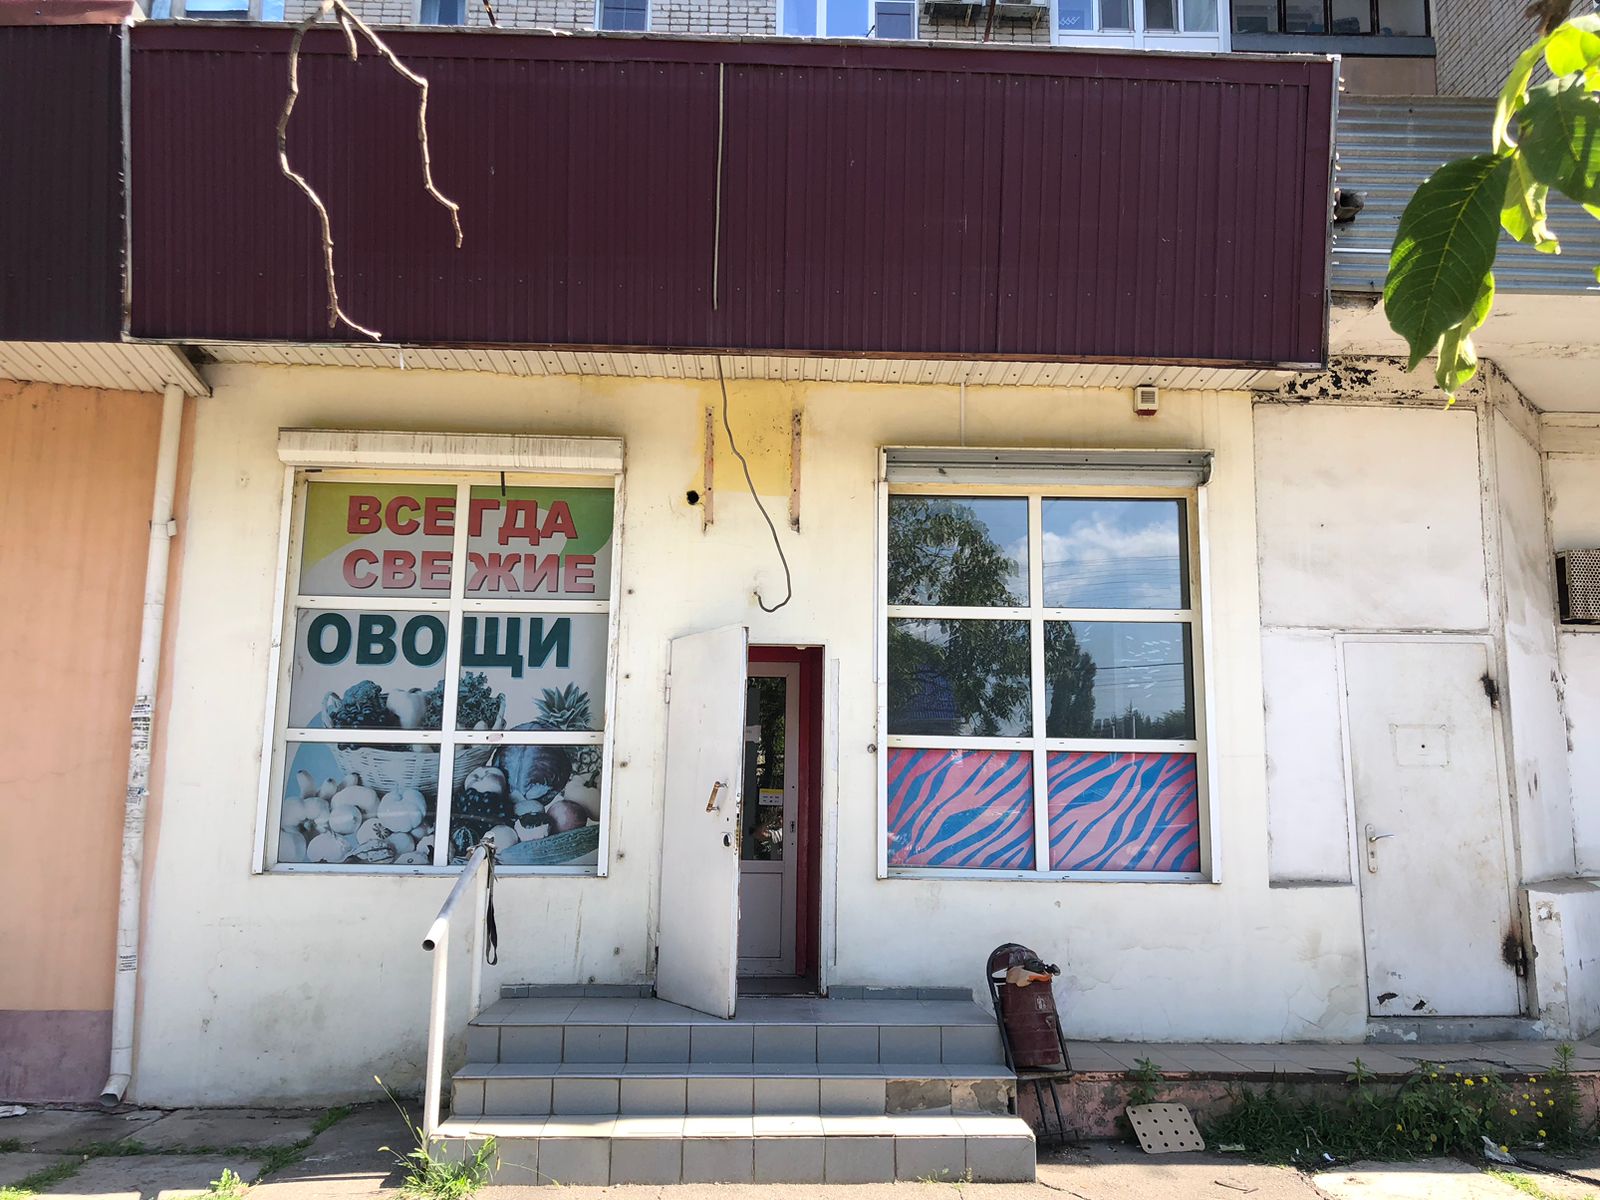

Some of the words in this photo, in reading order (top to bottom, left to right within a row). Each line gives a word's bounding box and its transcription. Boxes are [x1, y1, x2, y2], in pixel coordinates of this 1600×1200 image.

[347, 495, 578, 546] ВСЕГДА
[342, 549, 596, 593] СВЕЖИЕ
[307, 612, 571, 678] ОВОЩИ
